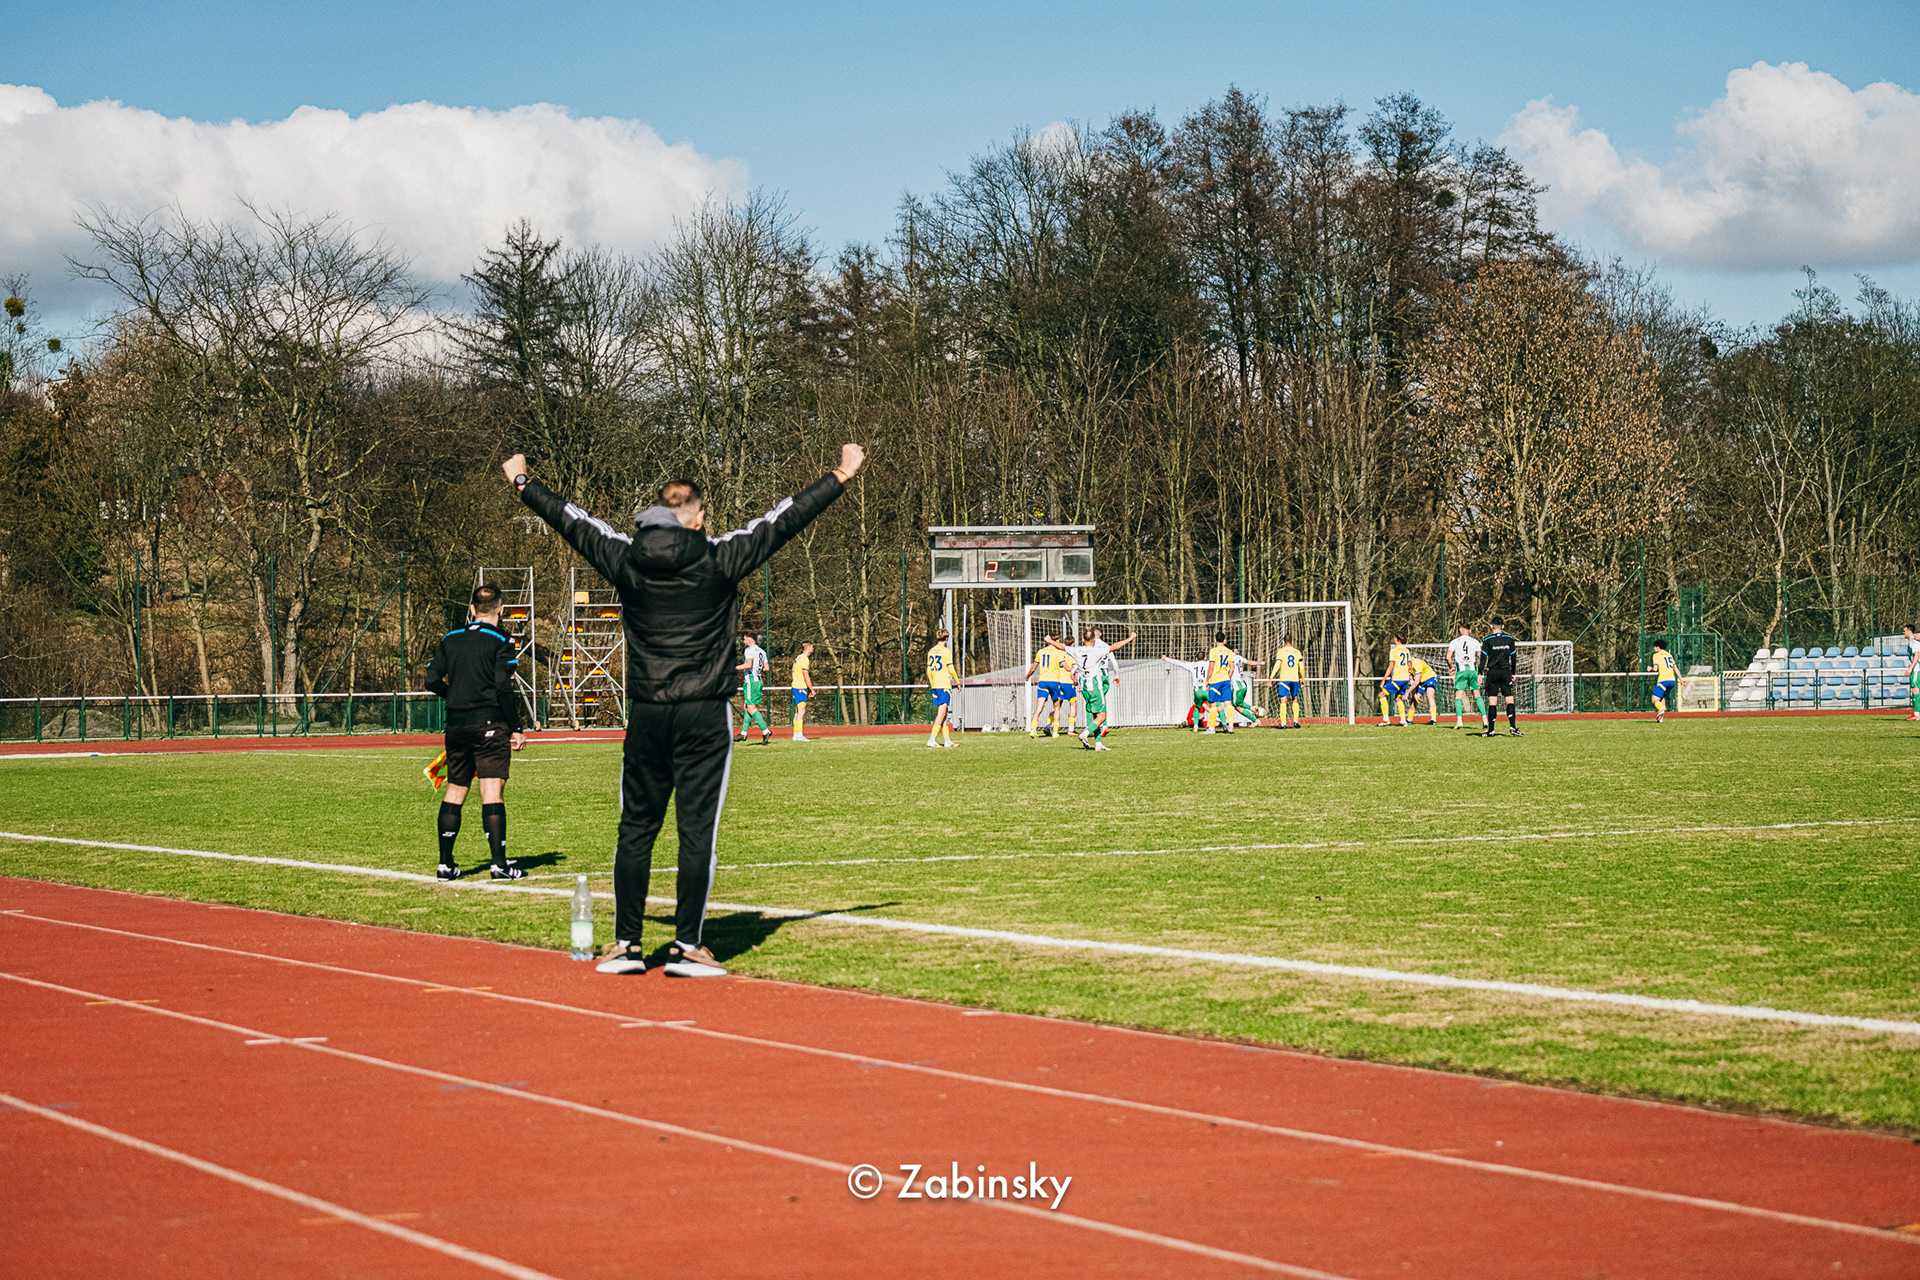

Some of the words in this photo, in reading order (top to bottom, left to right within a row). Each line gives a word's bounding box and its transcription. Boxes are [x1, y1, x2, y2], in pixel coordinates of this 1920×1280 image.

[942, 537, 1018, 548] GOSPODARZE
[984, 560, 998, 581] 2
[1462, 641, 1468, 654] 4
[929, 655, 943, 671] 23
[1042, 654, 1050, 669] 11
[1082, 654, 1088, 670] 7
[1219, 655, 1229, 667] 14
[1287, 654, 1295, 668] 8
[1400, 652, 1409, 666] 21
[1664, 657, 1673, 668] 15
[1194, 666, 1206, 679] 14
